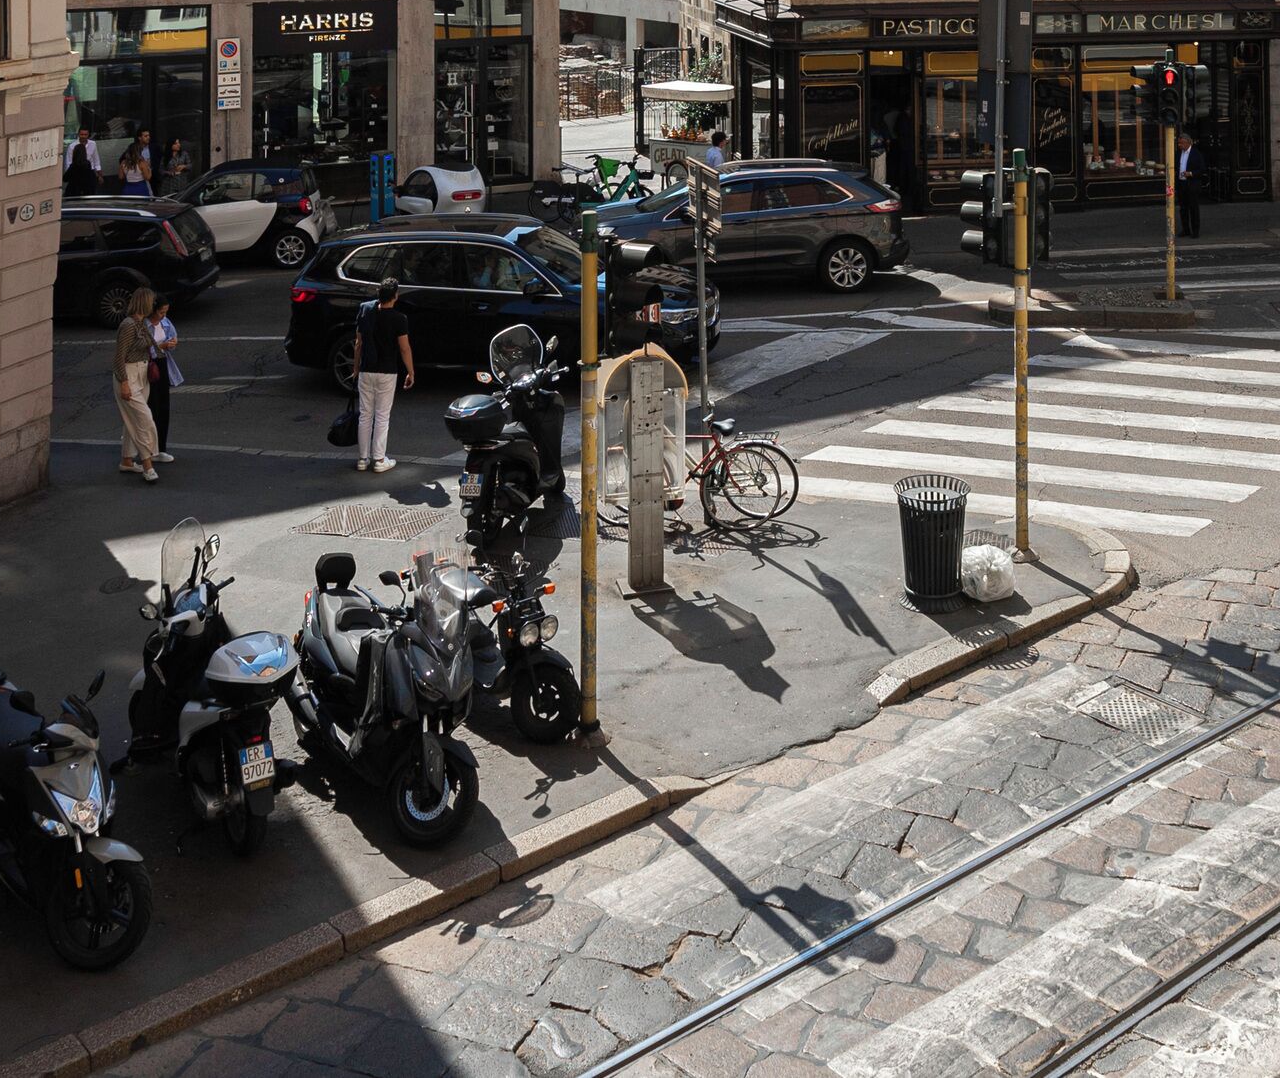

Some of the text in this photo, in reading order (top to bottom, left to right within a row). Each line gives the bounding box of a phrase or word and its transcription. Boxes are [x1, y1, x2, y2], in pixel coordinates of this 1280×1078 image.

[280, 12, 374, 31] HARRIS
[882, 12, 1223, 36] PASTICC MARCHESI
[308, 34, 346, 42] FIRENZE
[654, 147, 686, 163] GELATI
[248, 747, 261, 762] ER
[243, 761, 273, 781] 97072
